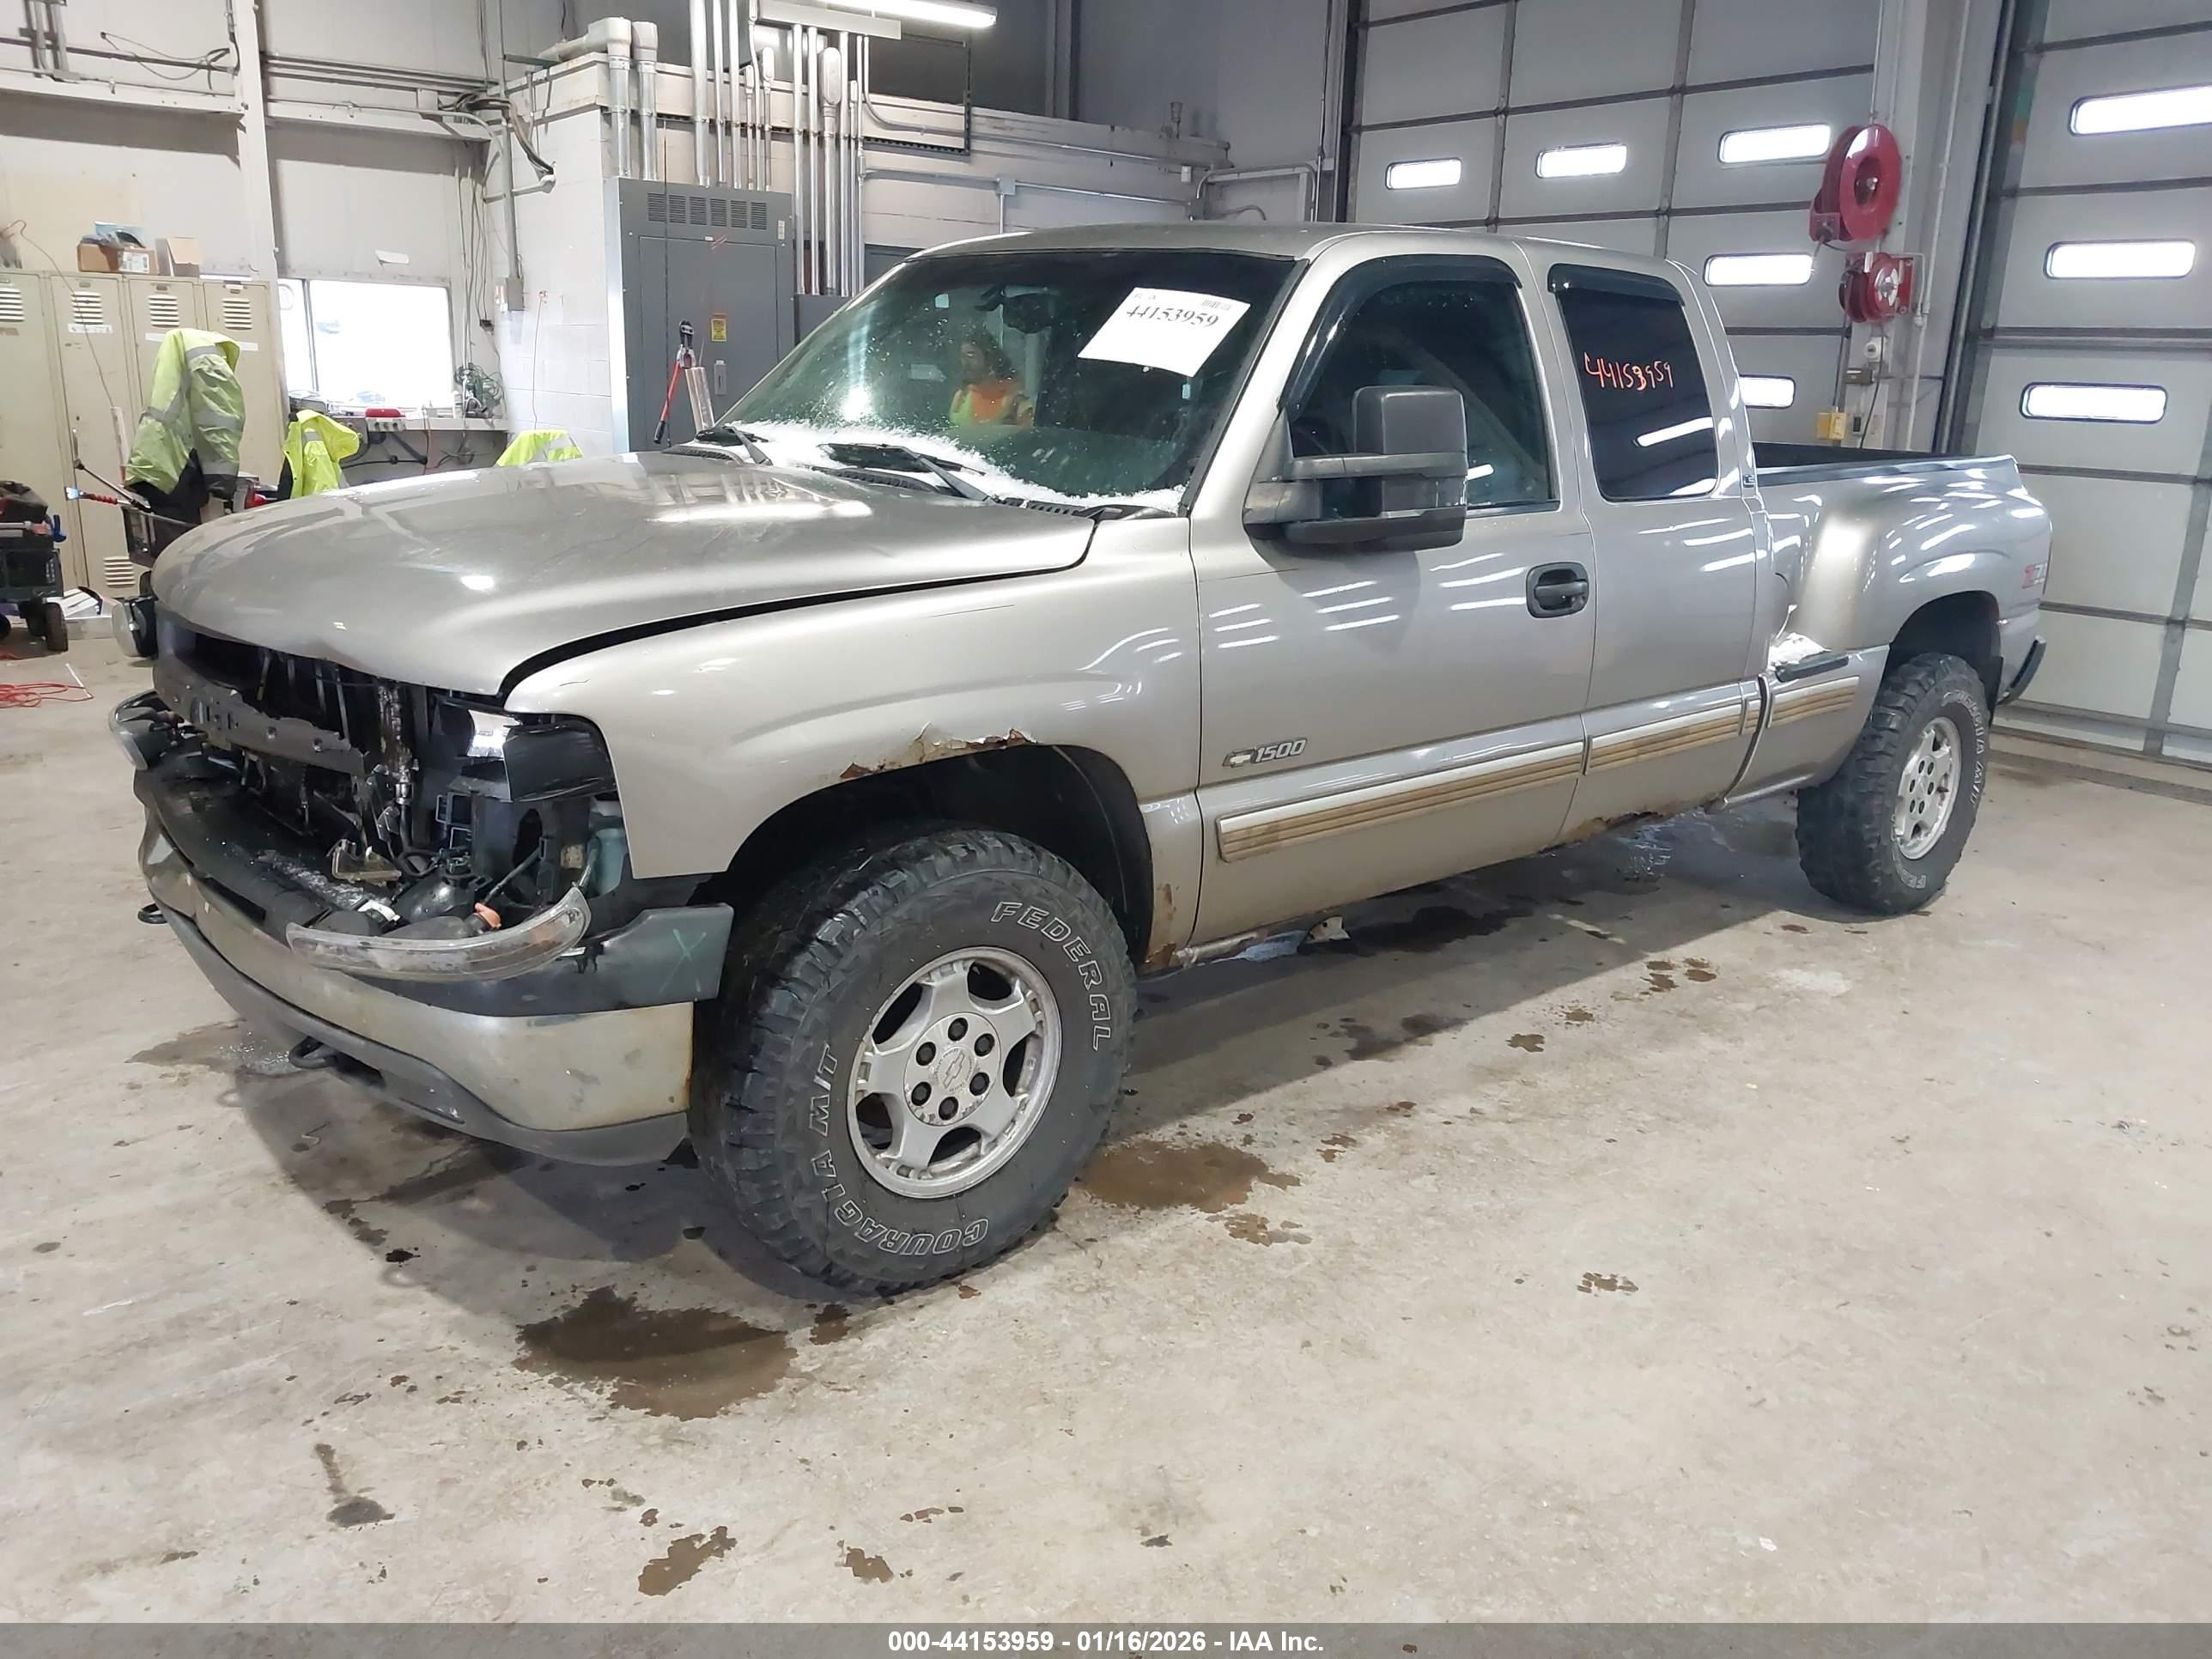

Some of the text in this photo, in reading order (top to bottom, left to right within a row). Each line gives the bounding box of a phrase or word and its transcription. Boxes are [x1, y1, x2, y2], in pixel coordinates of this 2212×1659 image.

[1126, 304, 1219, 326] 44153959
[1255, 738, 1308, 763] 1500
[991, 901, 1112, 1051] FEDERAL
[809, 1043, 989, 1256] COURAGIA M/T
